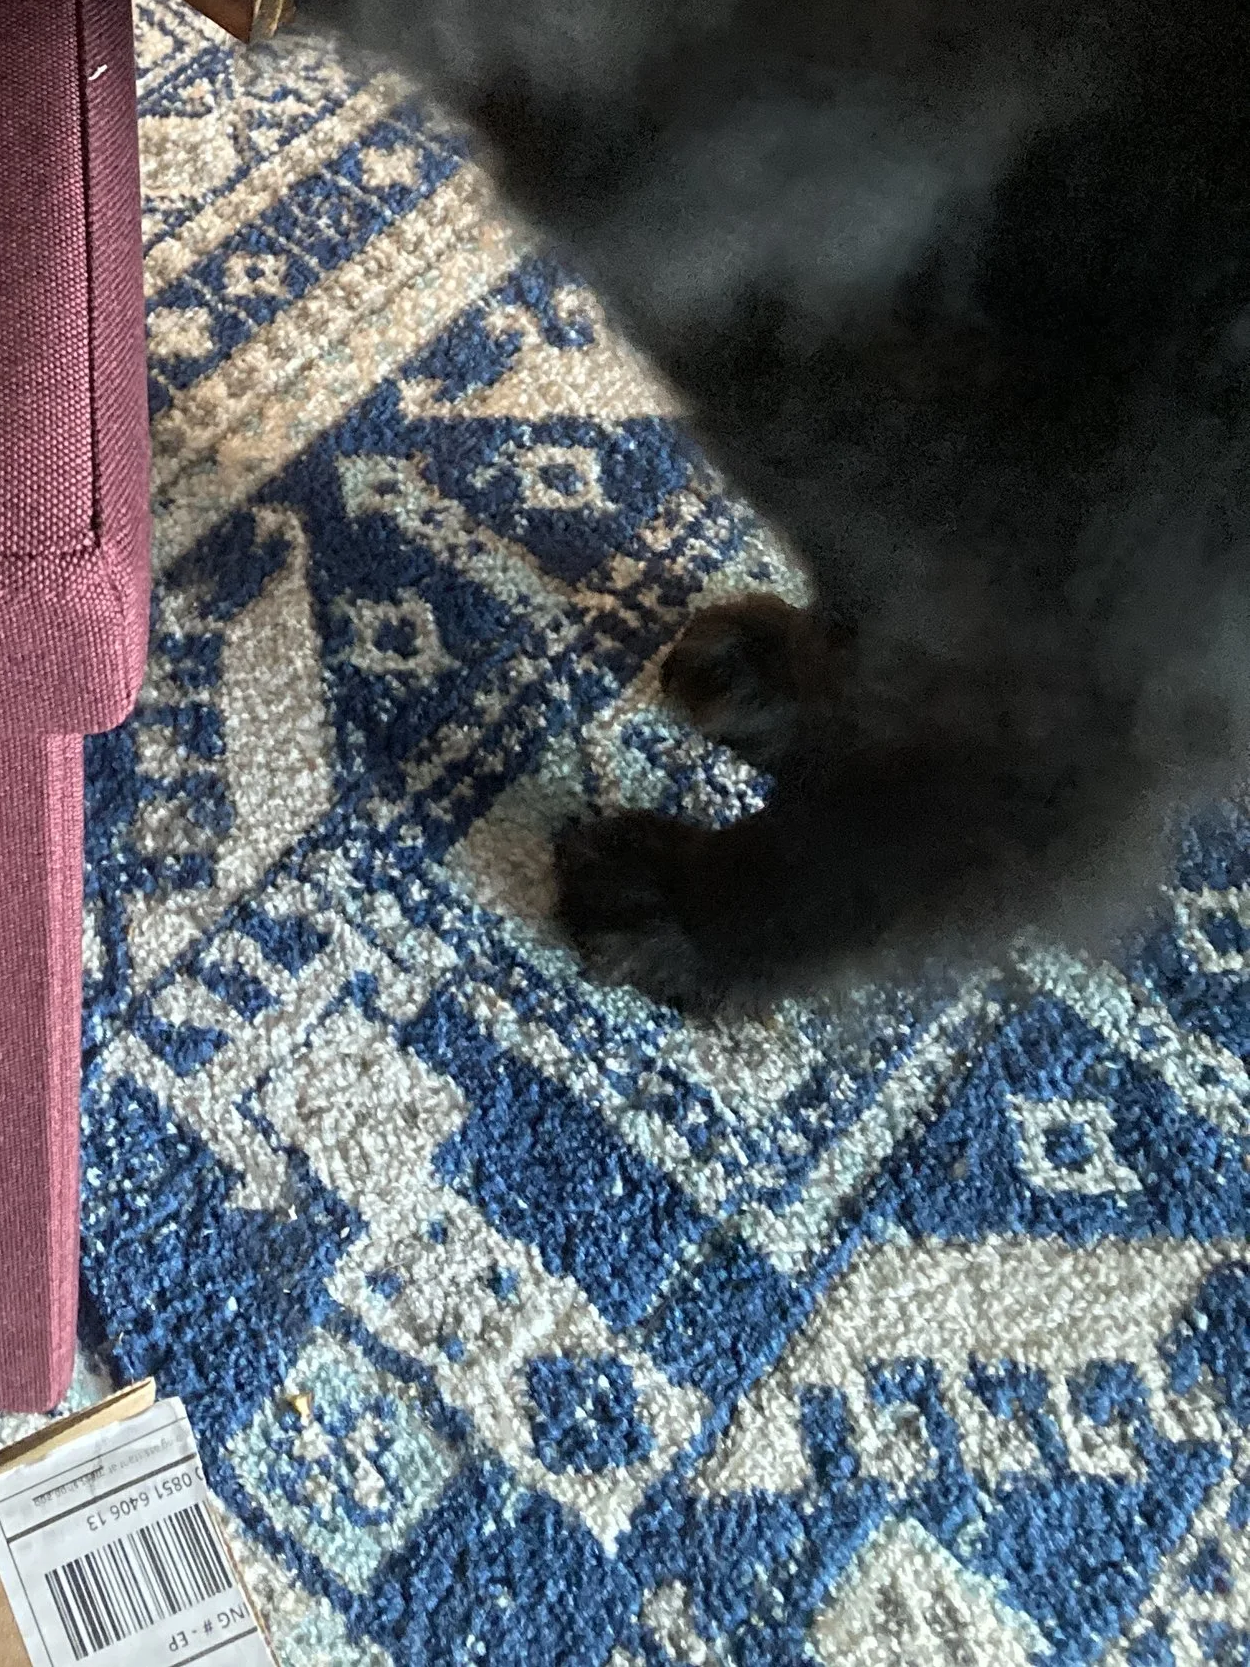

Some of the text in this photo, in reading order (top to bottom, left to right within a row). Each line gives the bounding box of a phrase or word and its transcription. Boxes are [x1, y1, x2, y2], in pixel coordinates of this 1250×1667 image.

[155, 1470, 193, 1501] 0851
[109, 1490, 150, 1521] 6406
[85, 1509, 108, 1532] 13
[167, 1629, 190, 1653] EP
